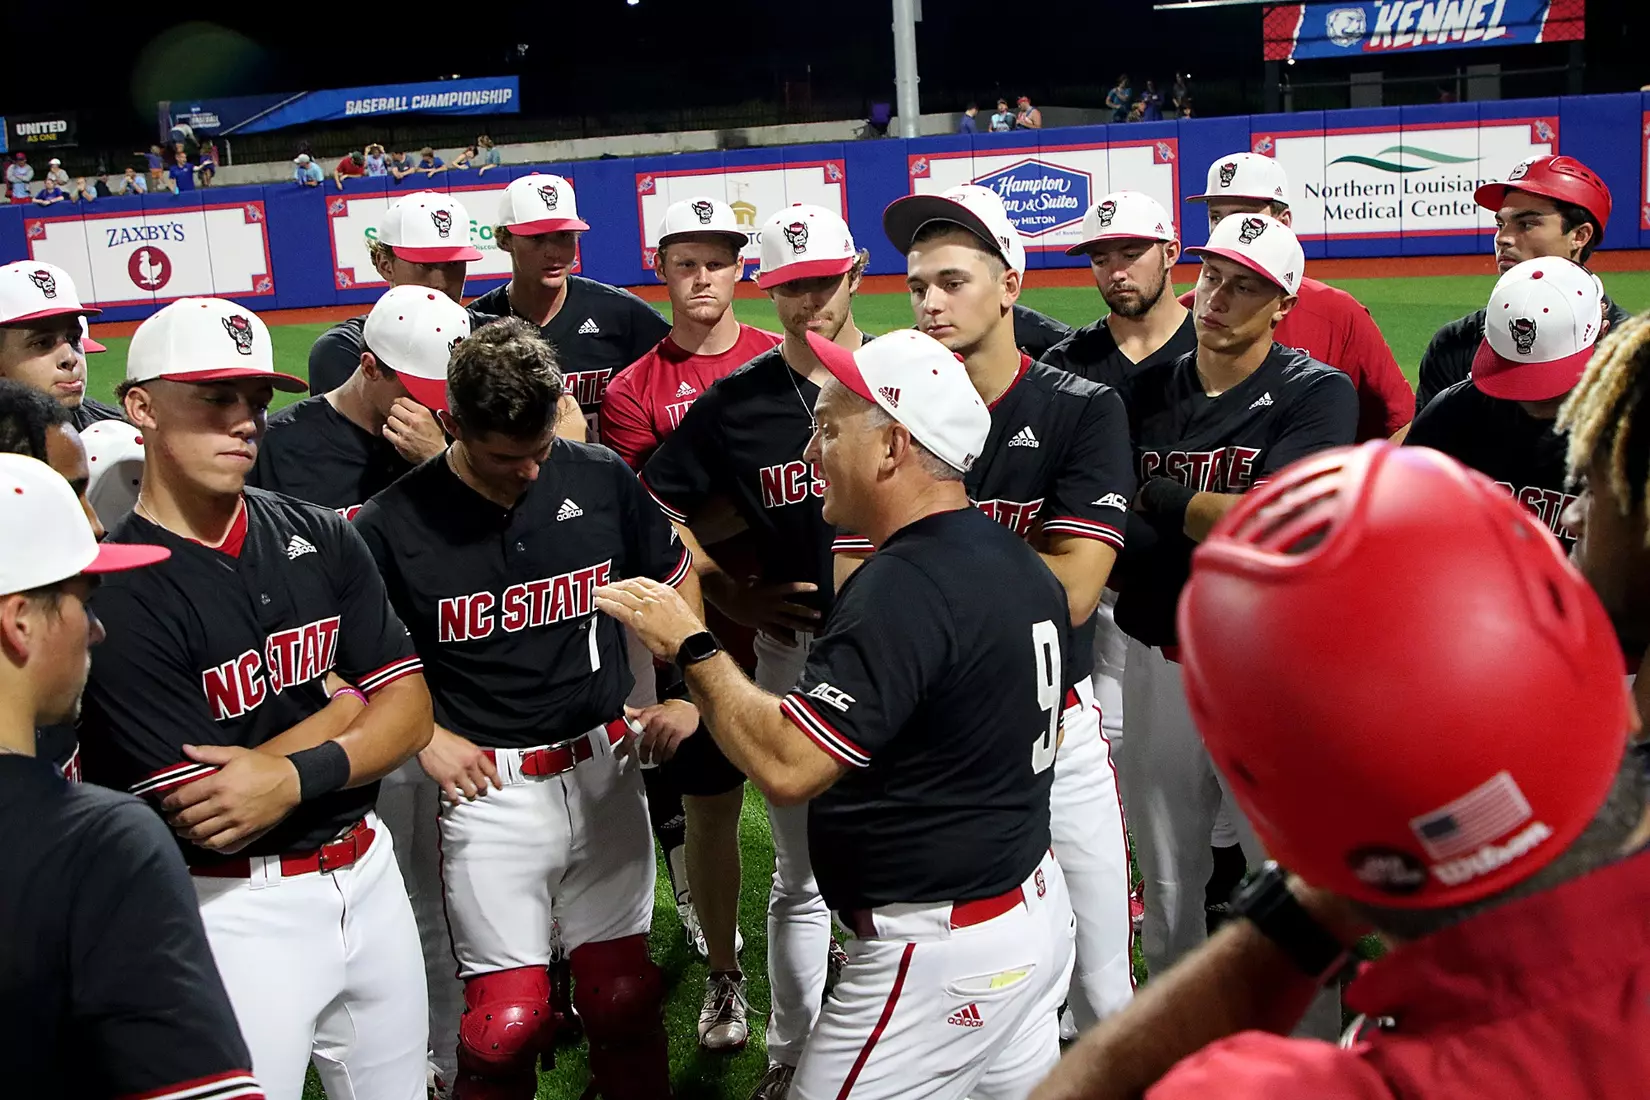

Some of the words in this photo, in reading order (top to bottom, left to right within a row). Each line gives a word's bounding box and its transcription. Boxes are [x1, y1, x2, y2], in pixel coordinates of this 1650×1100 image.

[1370, 0, 1507, 48] KENNEL
[345, 96, 409, 115] BASEBALL
[411, 88, 513, 110] CHAMPIONSHIP
[16, 120, 67, 136] UNITED
[27, 134, 39, 143] AS
[39, 133, 57, 142] ONE
[991, 175, 1071, 197] Hampton
[1305, 180, 1395, 199] Northern
[1026, 199, 1037, 212] &
[1035, 193, 1079, 211] Suites
[1324, 201, 1403, 221] Medical
[1411, 200, 1479, 217] Center
[1021, 216, 1056, 225] HILTON
[106, 221, 185, 248] ZAXBY'S
[578, 327, 600, 335] adidas
[675, 387, 697, 398] adidas
[878, 387, 899, 409] adidas
[1008, 436, 1040, 448] adidas
[759, 459, 808, 508] NC
[556, 508, 583, 521] adidas
[438, 591, 495, 642] NC
[202, 649, 267, 720] NC
[806, 682, 856, 712] ACC
[1031, 619, 1062, 775] 9
[947, 1016, 984, 1028] adidas
